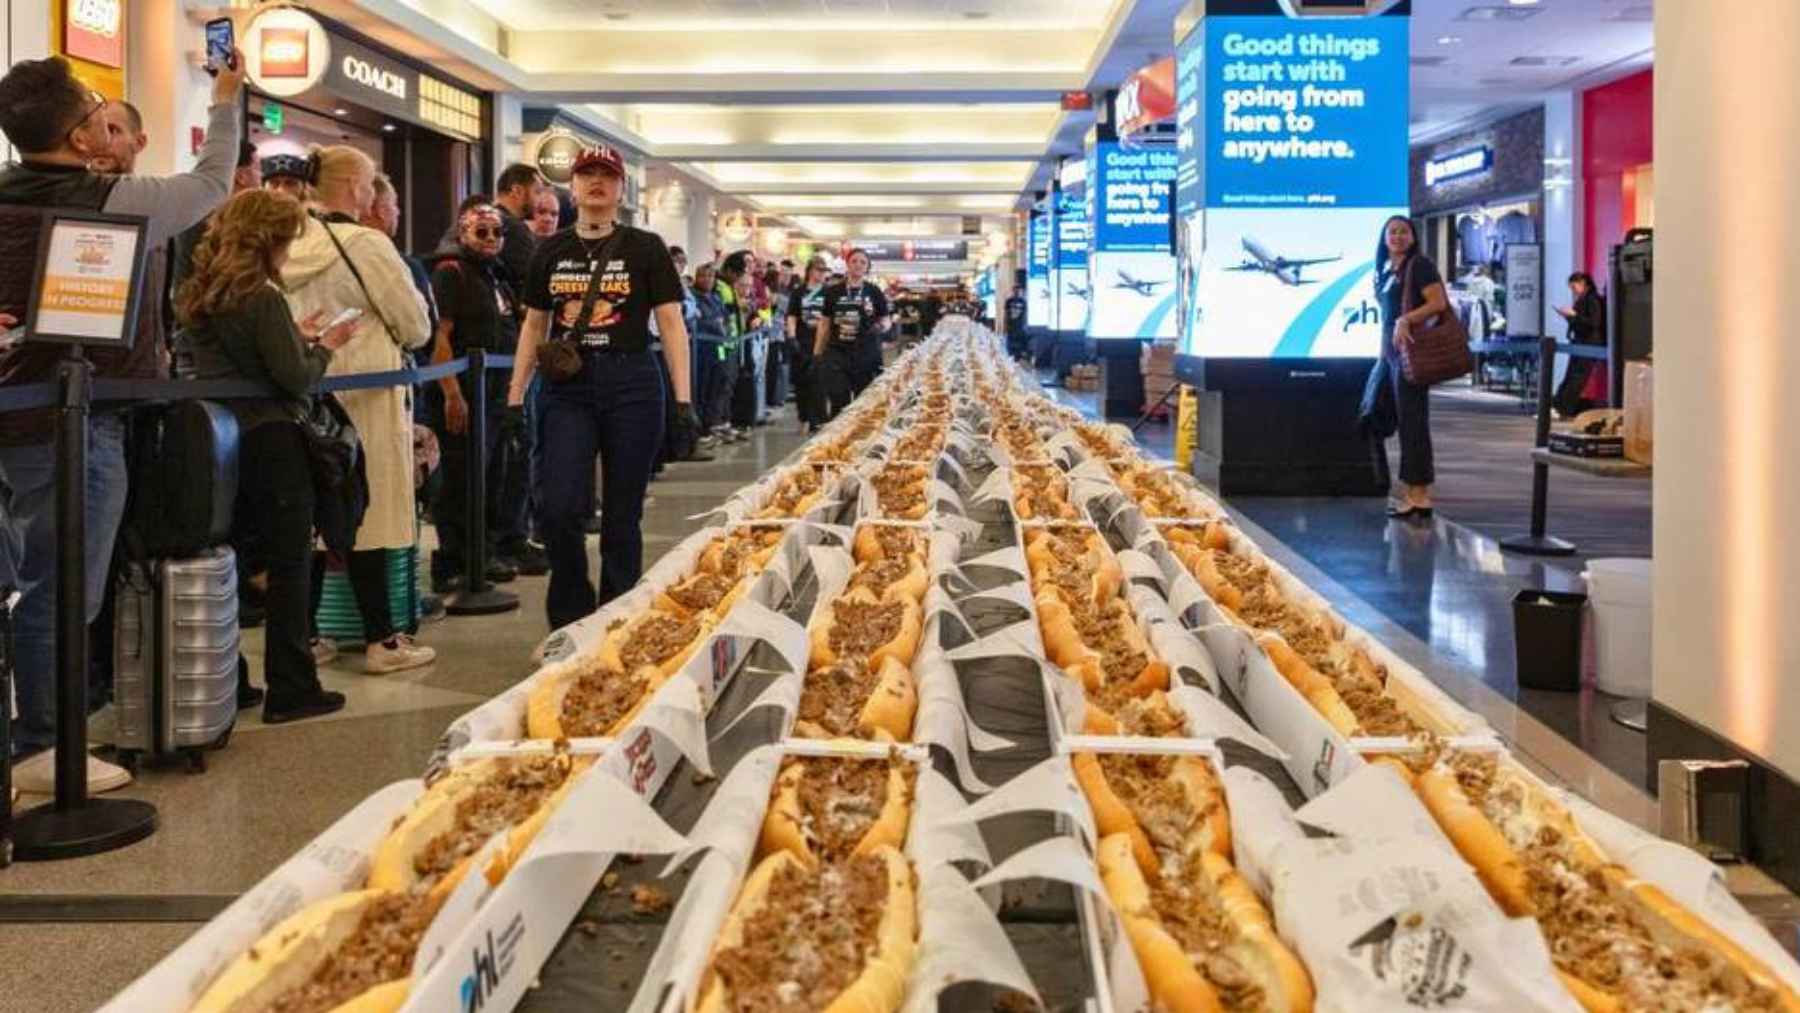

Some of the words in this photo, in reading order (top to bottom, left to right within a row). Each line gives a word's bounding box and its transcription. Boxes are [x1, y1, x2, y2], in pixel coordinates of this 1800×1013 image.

[1223, 33, 1294, 56] Good
[1298, 33, 1380, 61] things
[343, 56, 406, 99] COACH
[1223, 60, 1284, 82] start
[1287, 60, 1346, 81] with
[1223, 84, 1298, 112] going
[1302, 84, 1365, 107] from
[1223, 107, 1282, 132] here
[1285, 111, 1315, 132] to
[584, 144, 617, 161] PHL
[1223, 135, 1356, 163] anywhere.
[1106, 152, 1147, 167] Good
[1106, 167, 1142, 181] start
[1145, 167, 1177, 181] with
[1106, 182, 1149, 199] going
[1106, 196, 1142, 211] here
[1143, 197, 1160, 211] to
[59, 280, 114, 296] HISTORY
